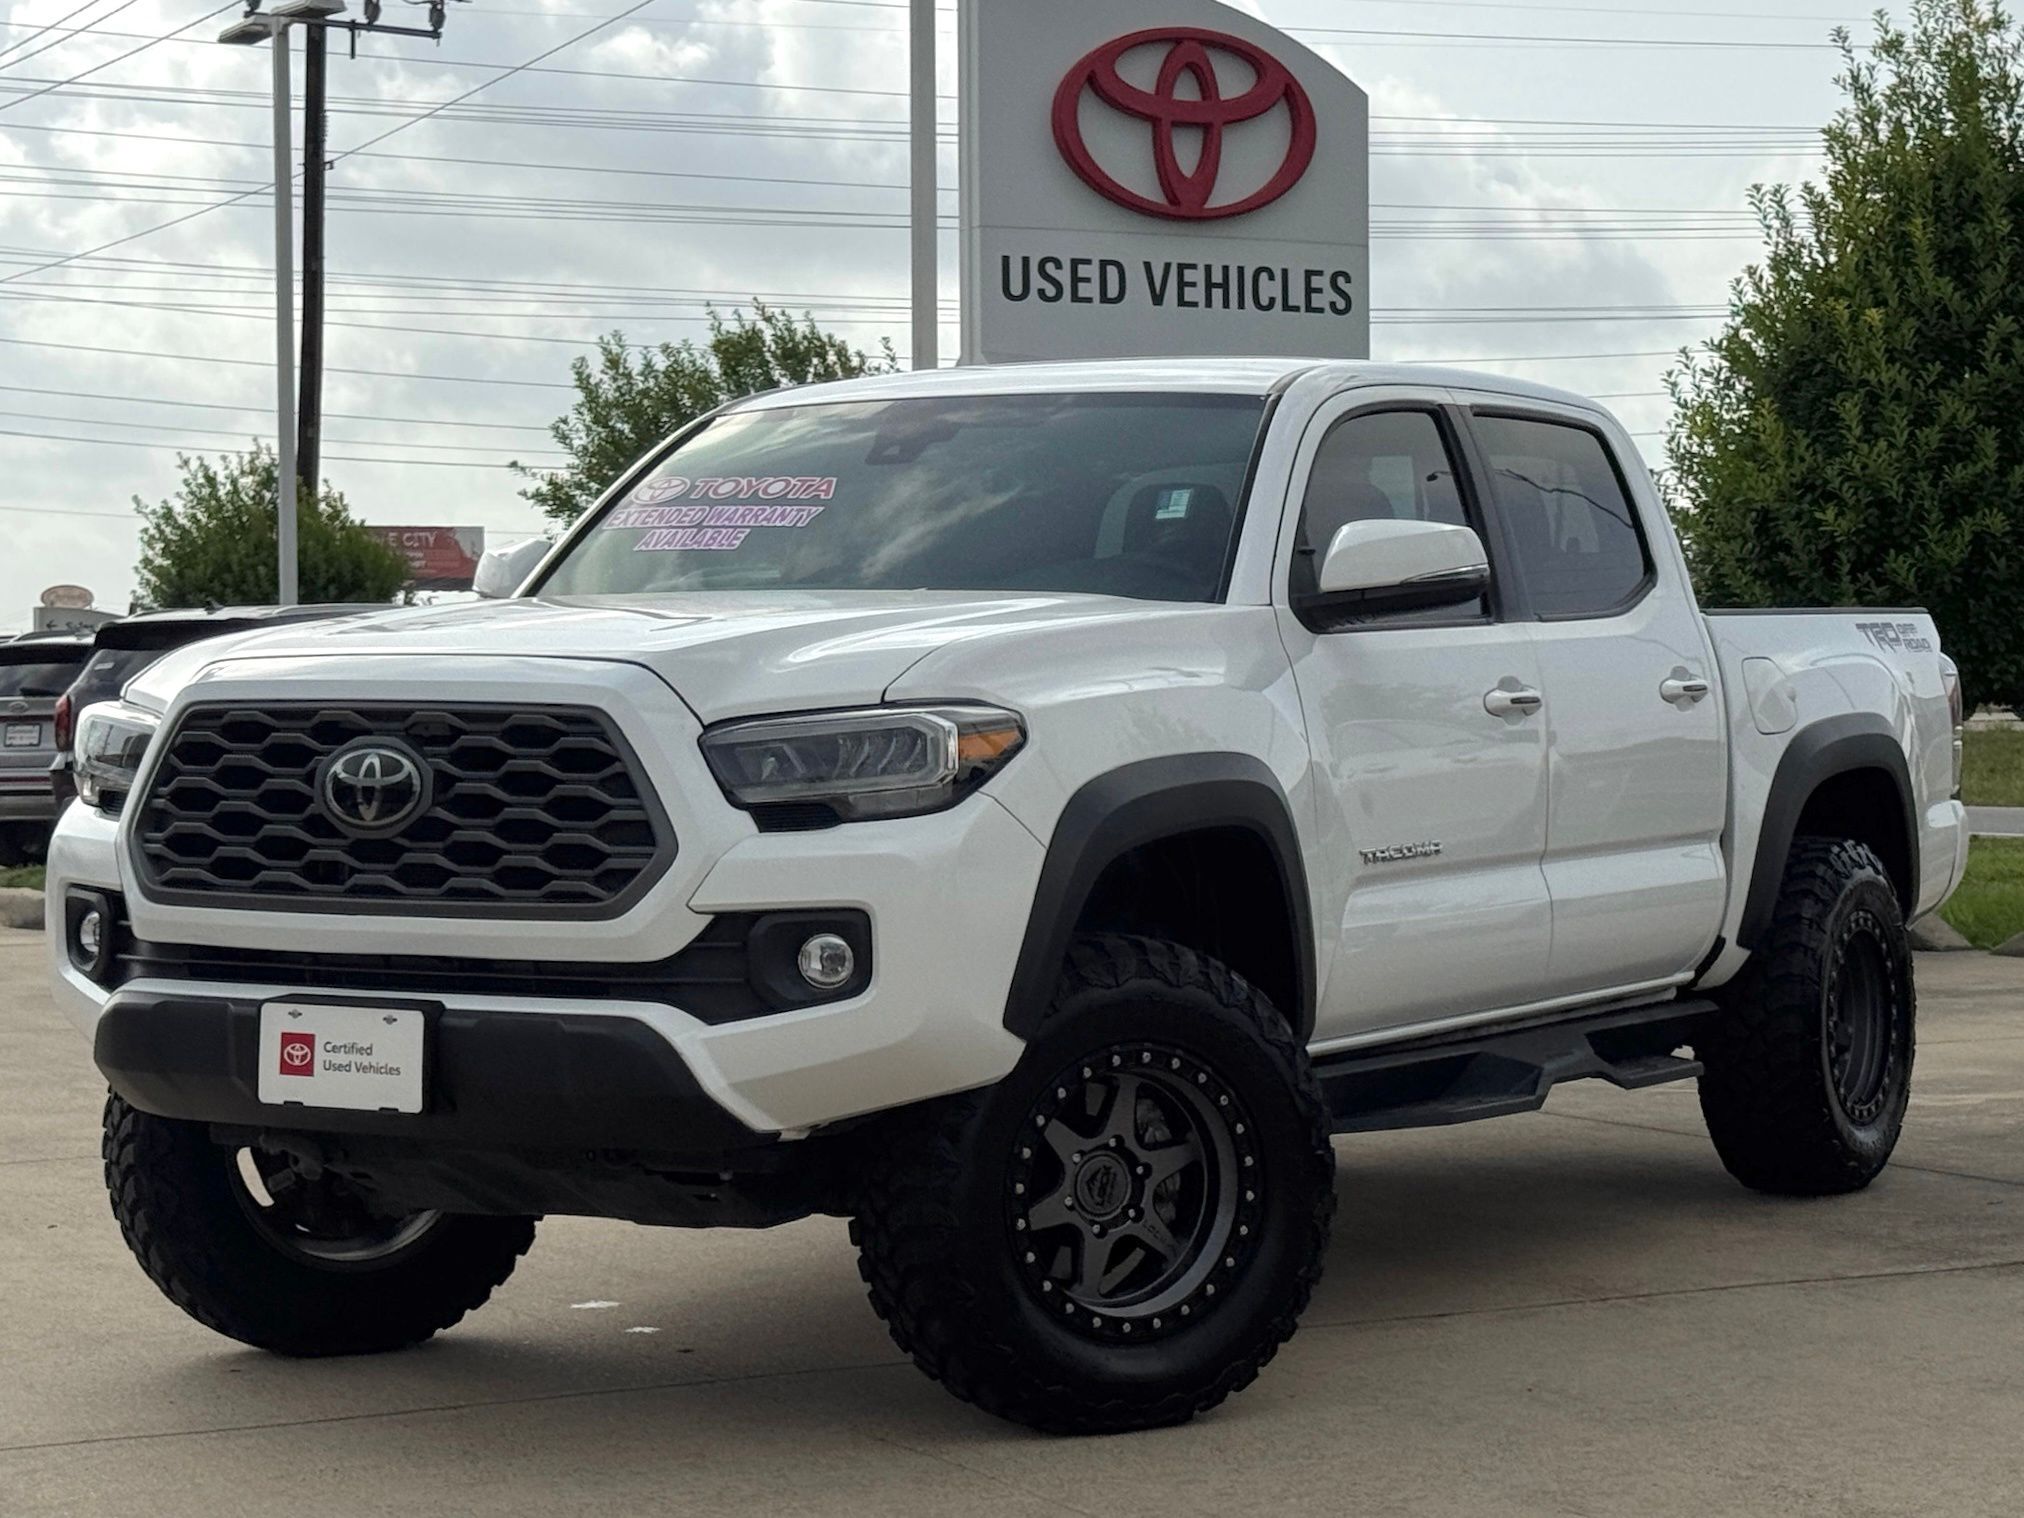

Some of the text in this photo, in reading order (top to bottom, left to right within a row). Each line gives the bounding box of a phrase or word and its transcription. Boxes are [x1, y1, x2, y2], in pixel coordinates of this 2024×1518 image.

[1001, 255, 1353, 316] USED VEHICLES
[690, 477, 837, 499] TOYOTA
[605, 507, 824, 528] EXTENDED WARRANTY
[637, 529, 750, 550] AVAILABLE
[1855, 622, 1901, 653] TRD
[323, 1041, 373, 1056] Certified
[323, 1060, 401, 1076] Used Vehicles
